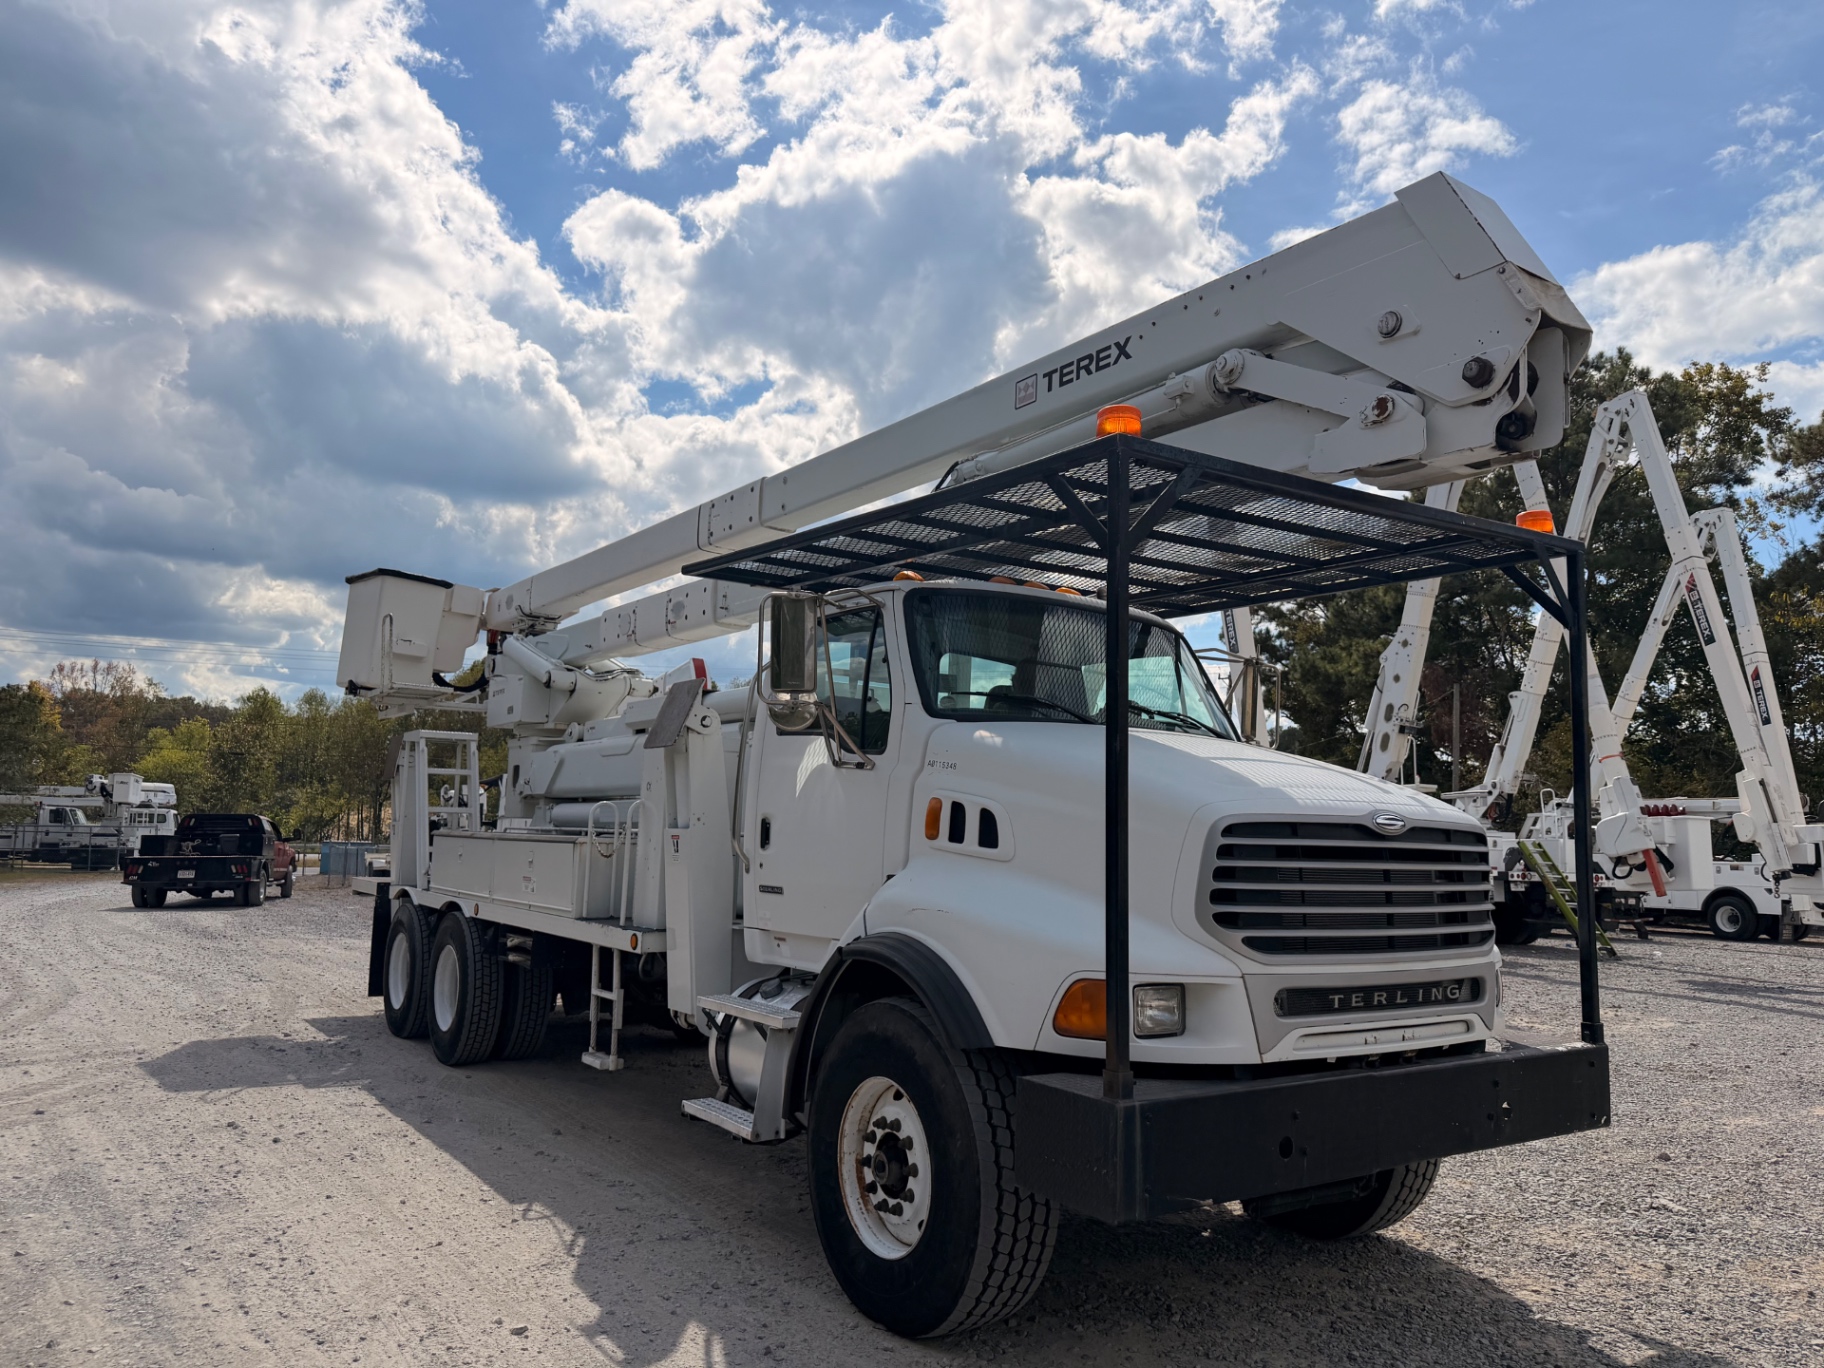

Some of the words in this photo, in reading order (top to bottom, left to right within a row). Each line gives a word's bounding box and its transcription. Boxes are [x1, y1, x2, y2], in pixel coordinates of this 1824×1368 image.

[1042, 335, 1132, 393] TEREX
[1226, 609, 1236, 647] TEREX
[1694, 602, 1711, 638] TEREX
[1757, 689, 1769, 719] TEREX
[1329, 984, 1460, 1009] TERLING
